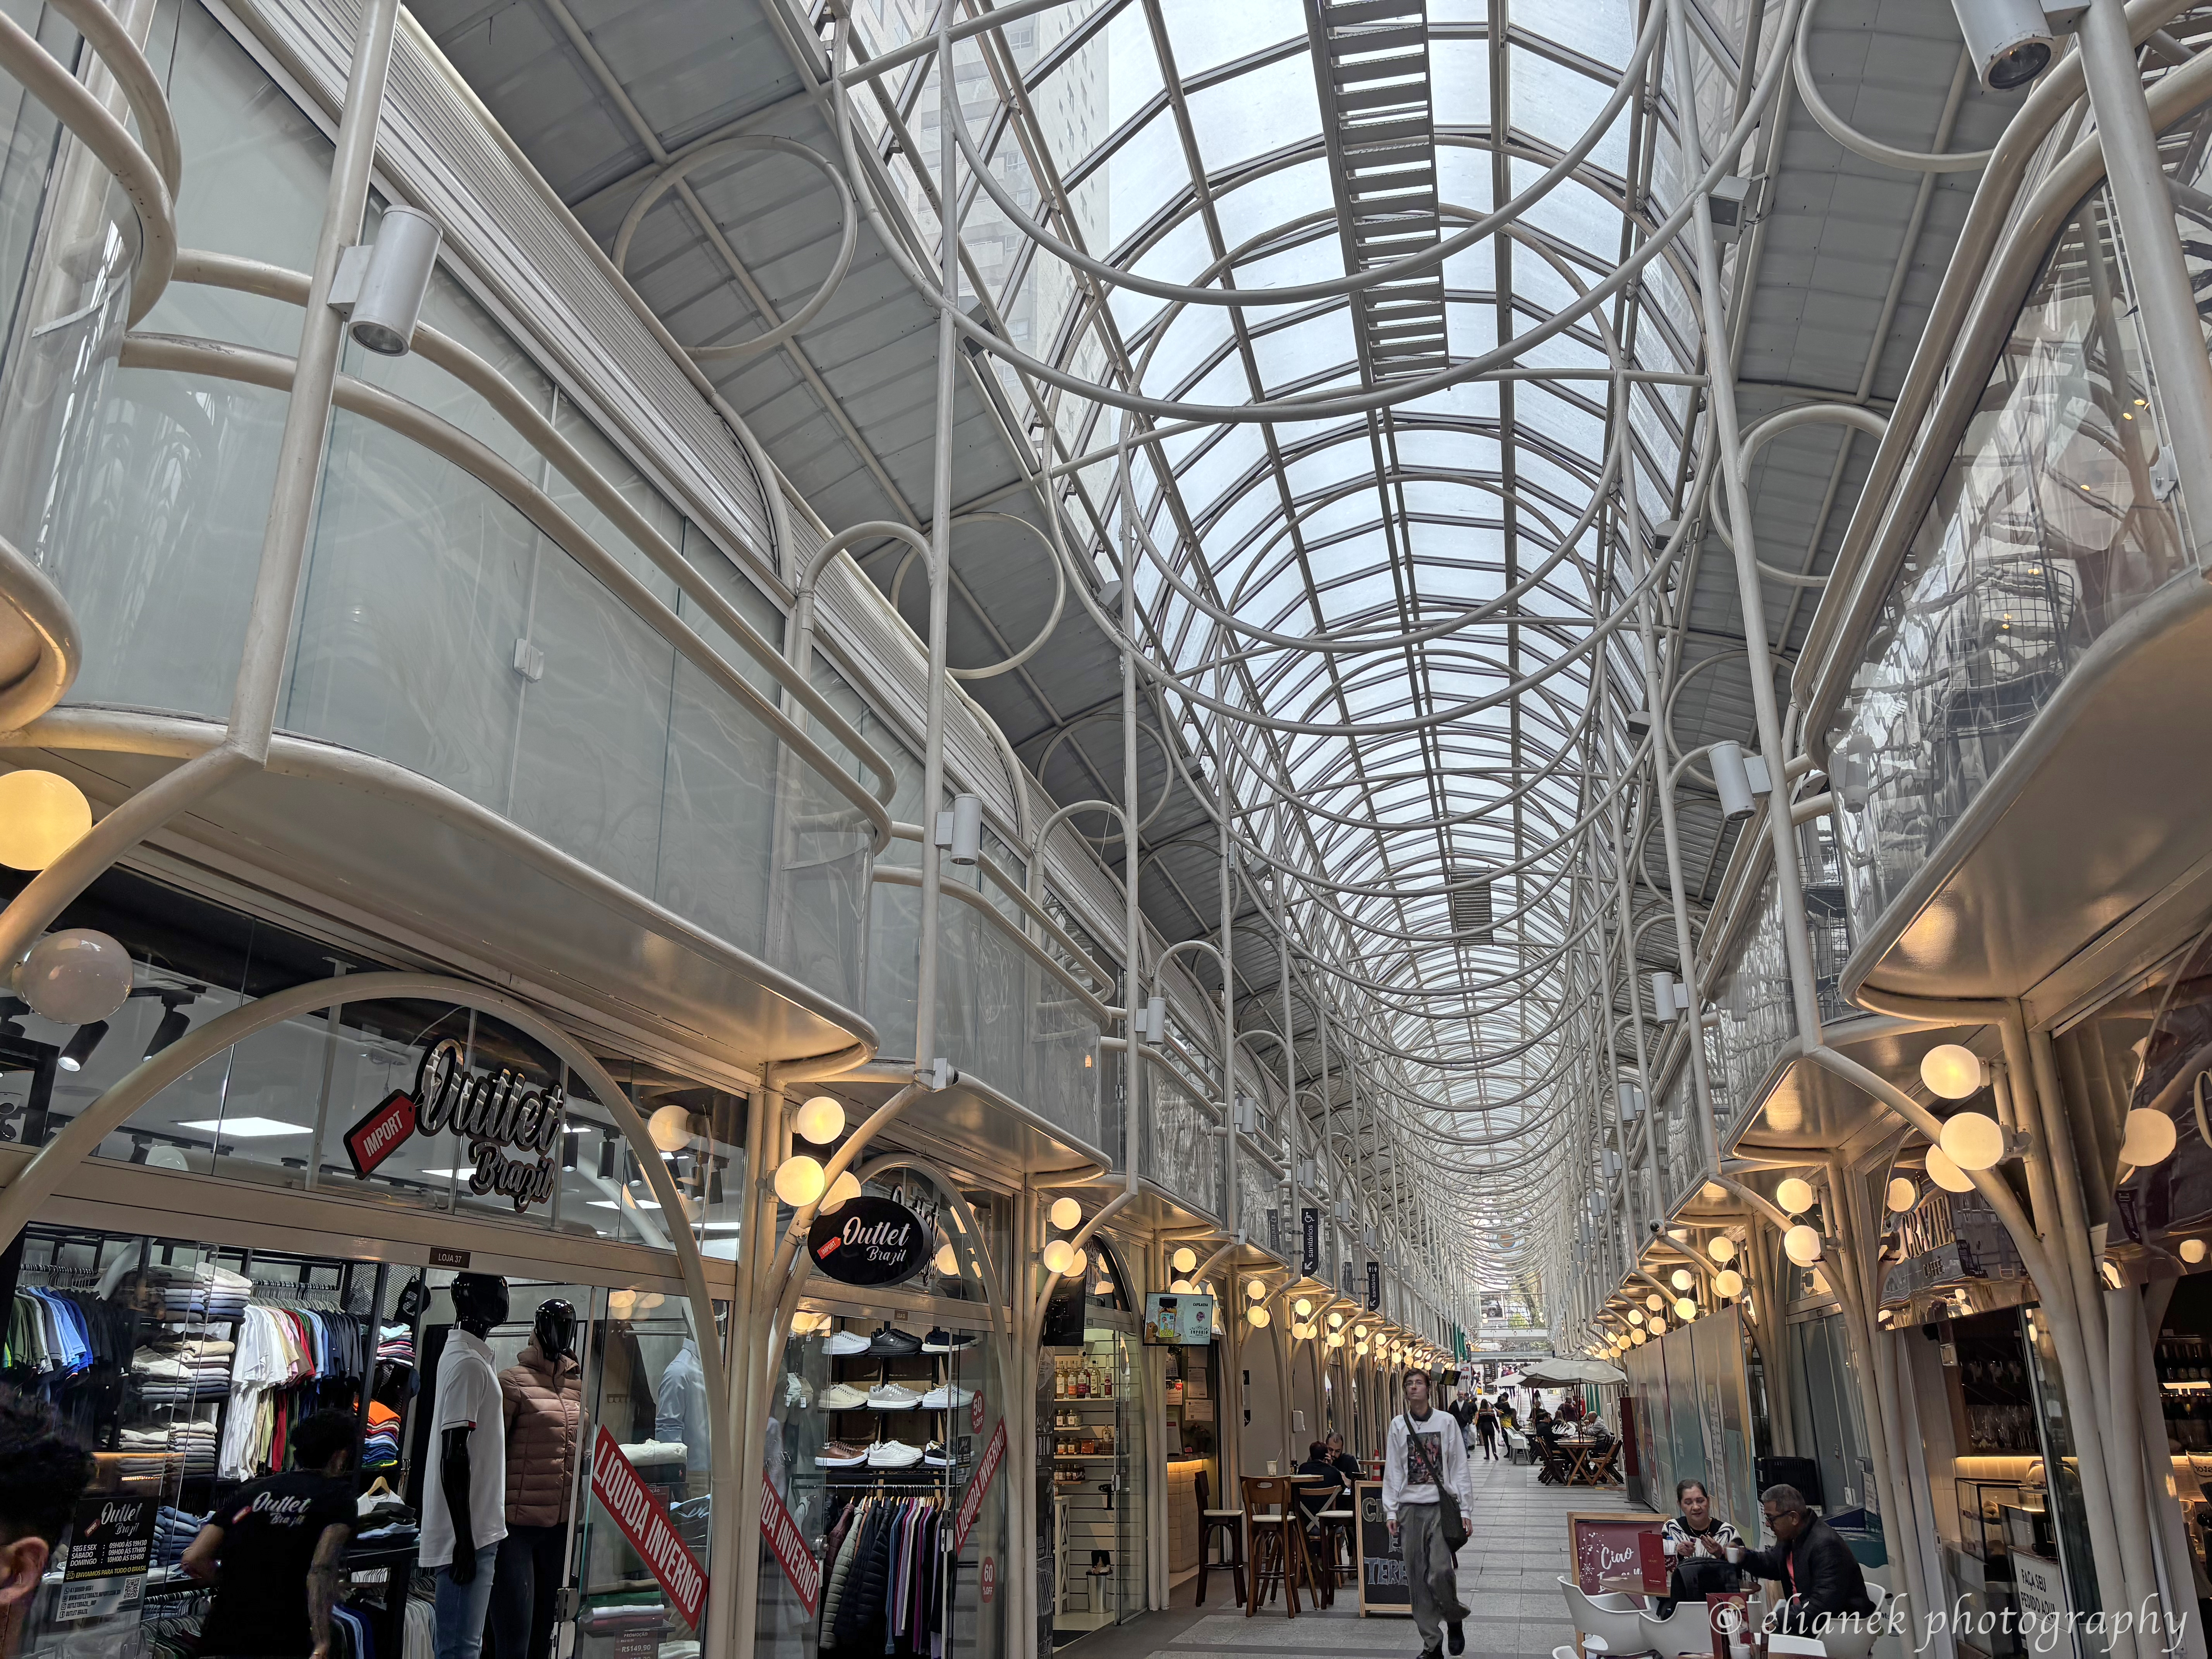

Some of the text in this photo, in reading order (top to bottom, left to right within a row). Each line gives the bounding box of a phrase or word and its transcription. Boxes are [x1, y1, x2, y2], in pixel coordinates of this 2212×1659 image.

[421, 1038, 563, 1150] Outlet
[363, 1110, 403, 1157] IMPORT
[474, 1142, 553, 1207] Brazil
[843, 1216, 911, 1246] Outlet
[438, 1253, 453, 1262] LOJA
[821, 1240, 836, 1255] IMPORT
[866, 1245, 907, 1266] Brazil
[974, 1395, 982, 1416] 50
[956, 1479, 981, 1545] LIQUIDA
[979, 1425, 1004, 1491] INVERNO
[252, 1492, 312, 1513] Outlet
[101, 1502, 143, 1525] Outlet
[115, 1523, 139, 1536] Brazil
[593, 1440, 702, 1613] LIQUIDA INVERNO
[70, 1558, 97, 1566] DOMINGO
[71, 1551, 93, 1559] SÁBADO
[776, 1515, 817, 1602] INVERNO
[1601, 1546, 1634, 1570] Ciao
[76, 1570, 101, 1578] ENVIAMOS
[984, 1564, 993, 1582] 60
[2021, 1569, 2046, 1592] FAÇA SEU
[983, 1586, 993, 1595] %OFF
[2020, 1591, 2040, 1613] PEDIDO
